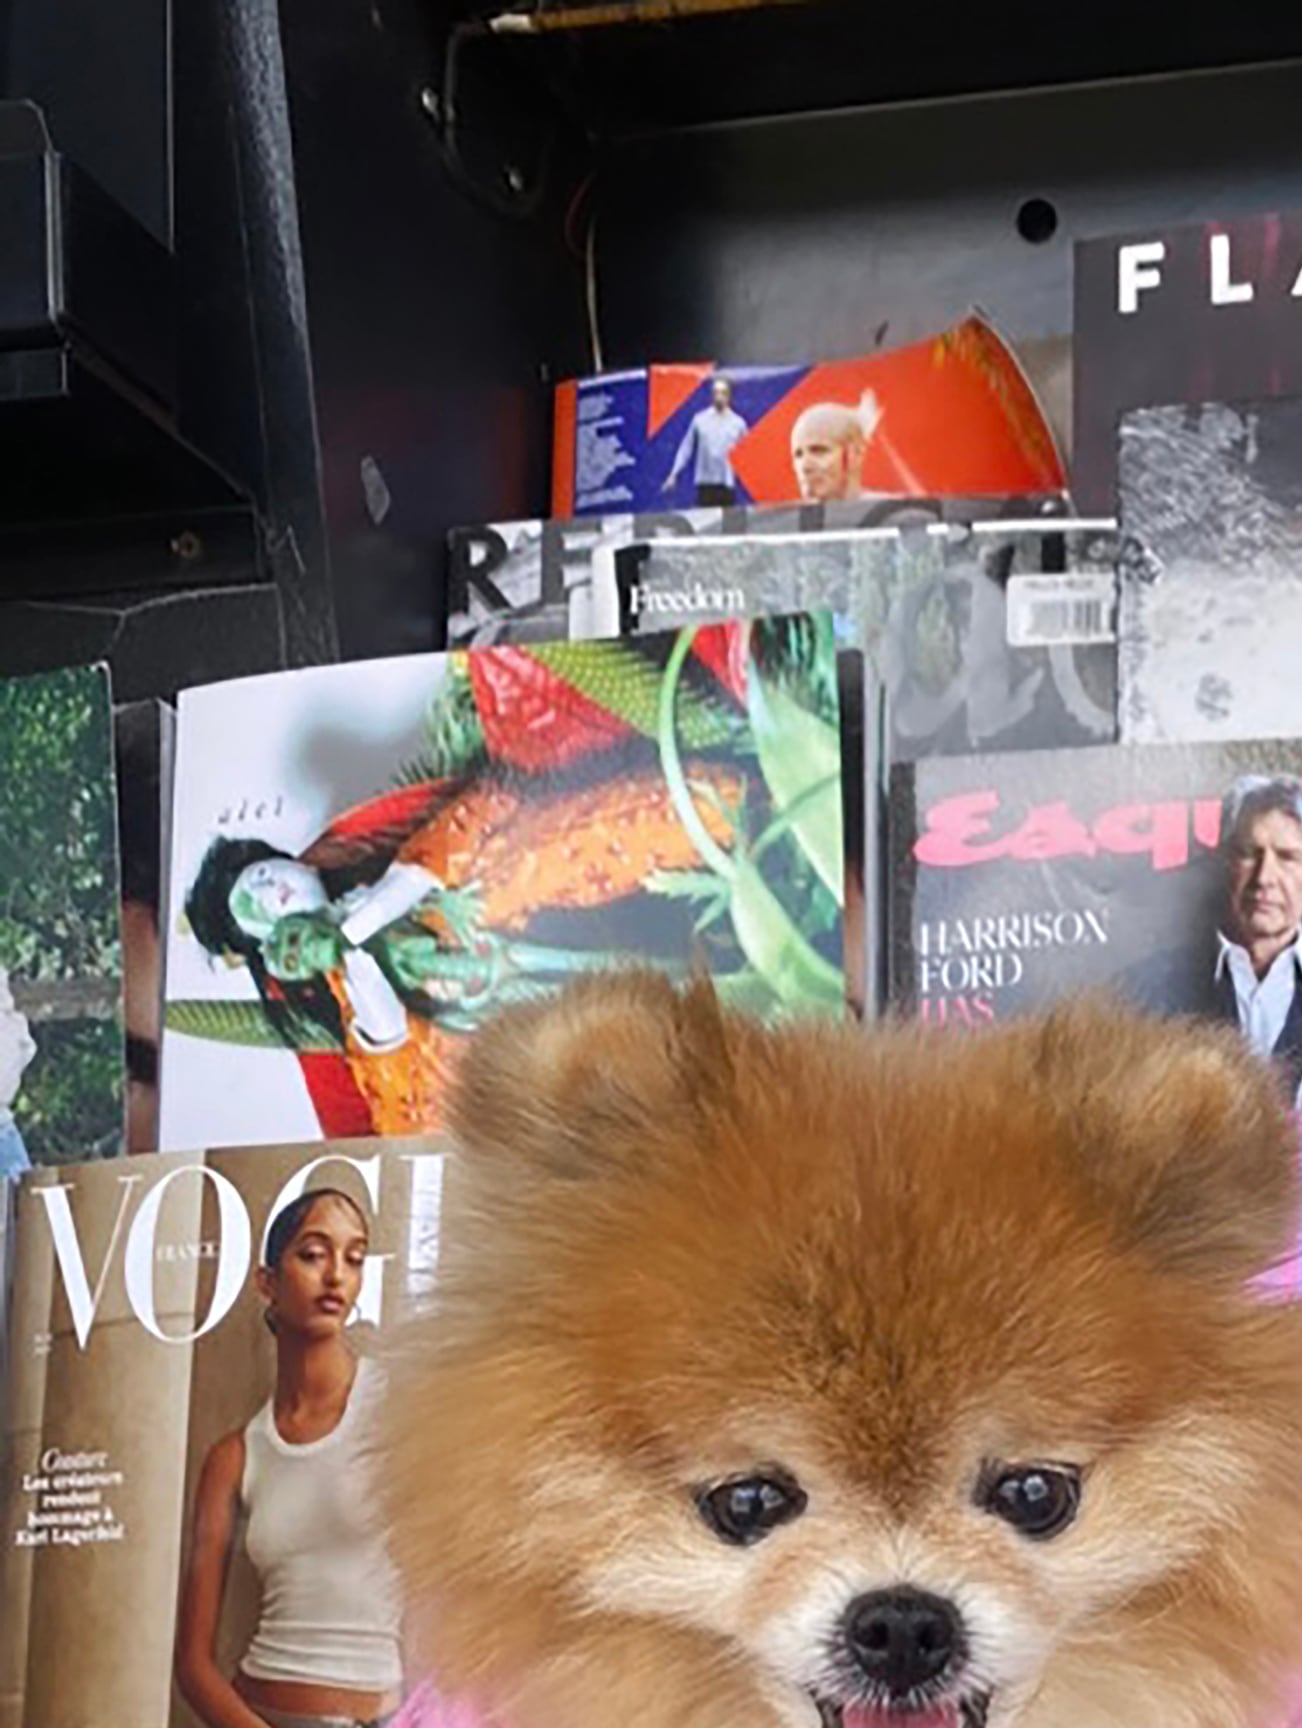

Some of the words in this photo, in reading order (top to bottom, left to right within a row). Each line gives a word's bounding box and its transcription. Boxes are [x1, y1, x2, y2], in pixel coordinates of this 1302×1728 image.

[629, 583, 745, 615] Freedom
[920, 908, 1109, 956] HARRISON
[920, 952, 1023, 993] FORD
